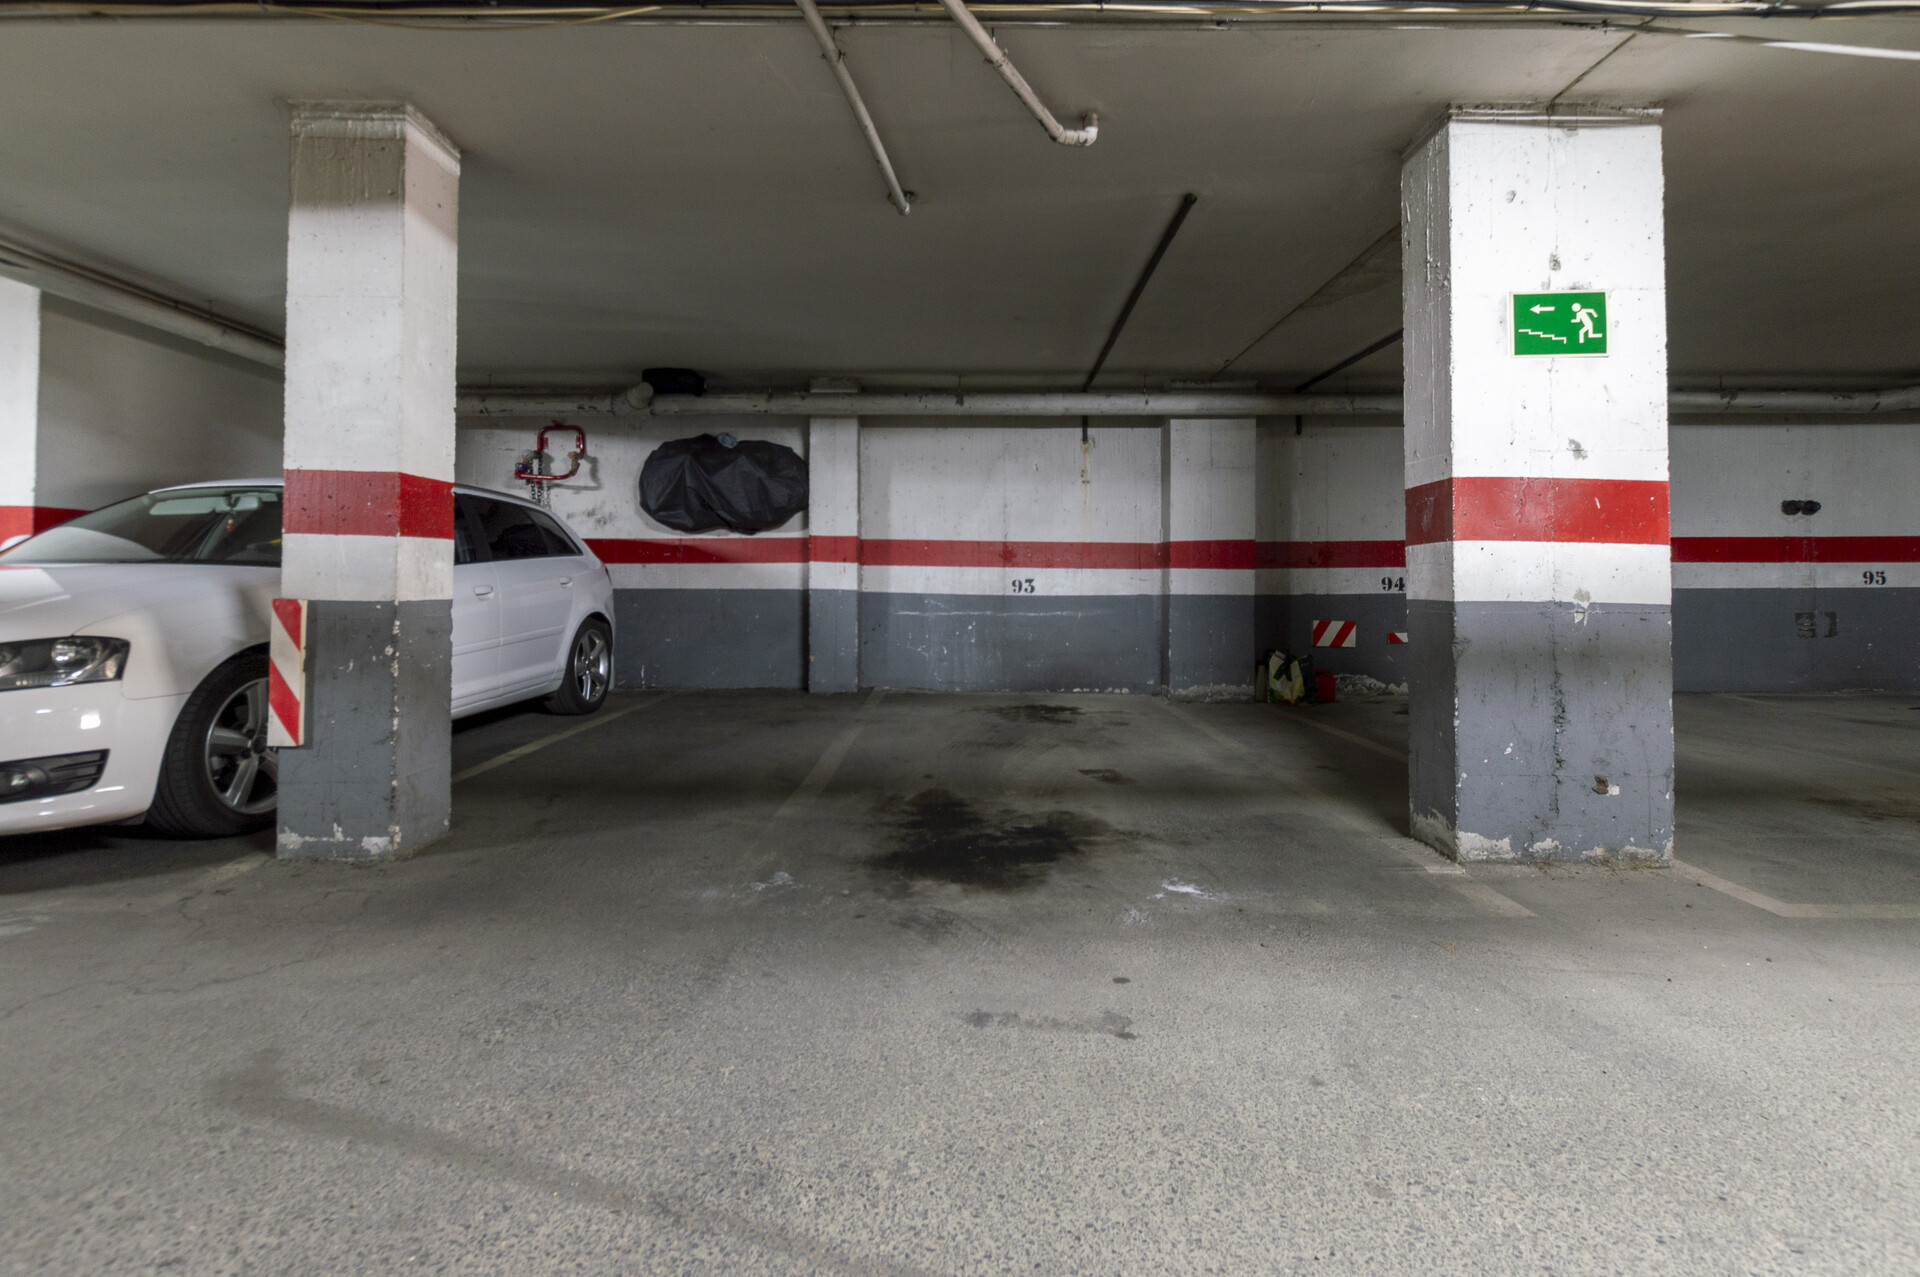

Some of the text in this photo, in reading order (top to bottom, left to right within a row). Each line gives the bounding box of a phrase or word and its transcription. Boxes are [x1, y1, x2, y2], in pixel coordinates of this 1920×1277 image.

[1011, 578, 1035, 594] 93
[1381, 576, 1405, 591] 94
[1862, 570, 1886, 586] 95
